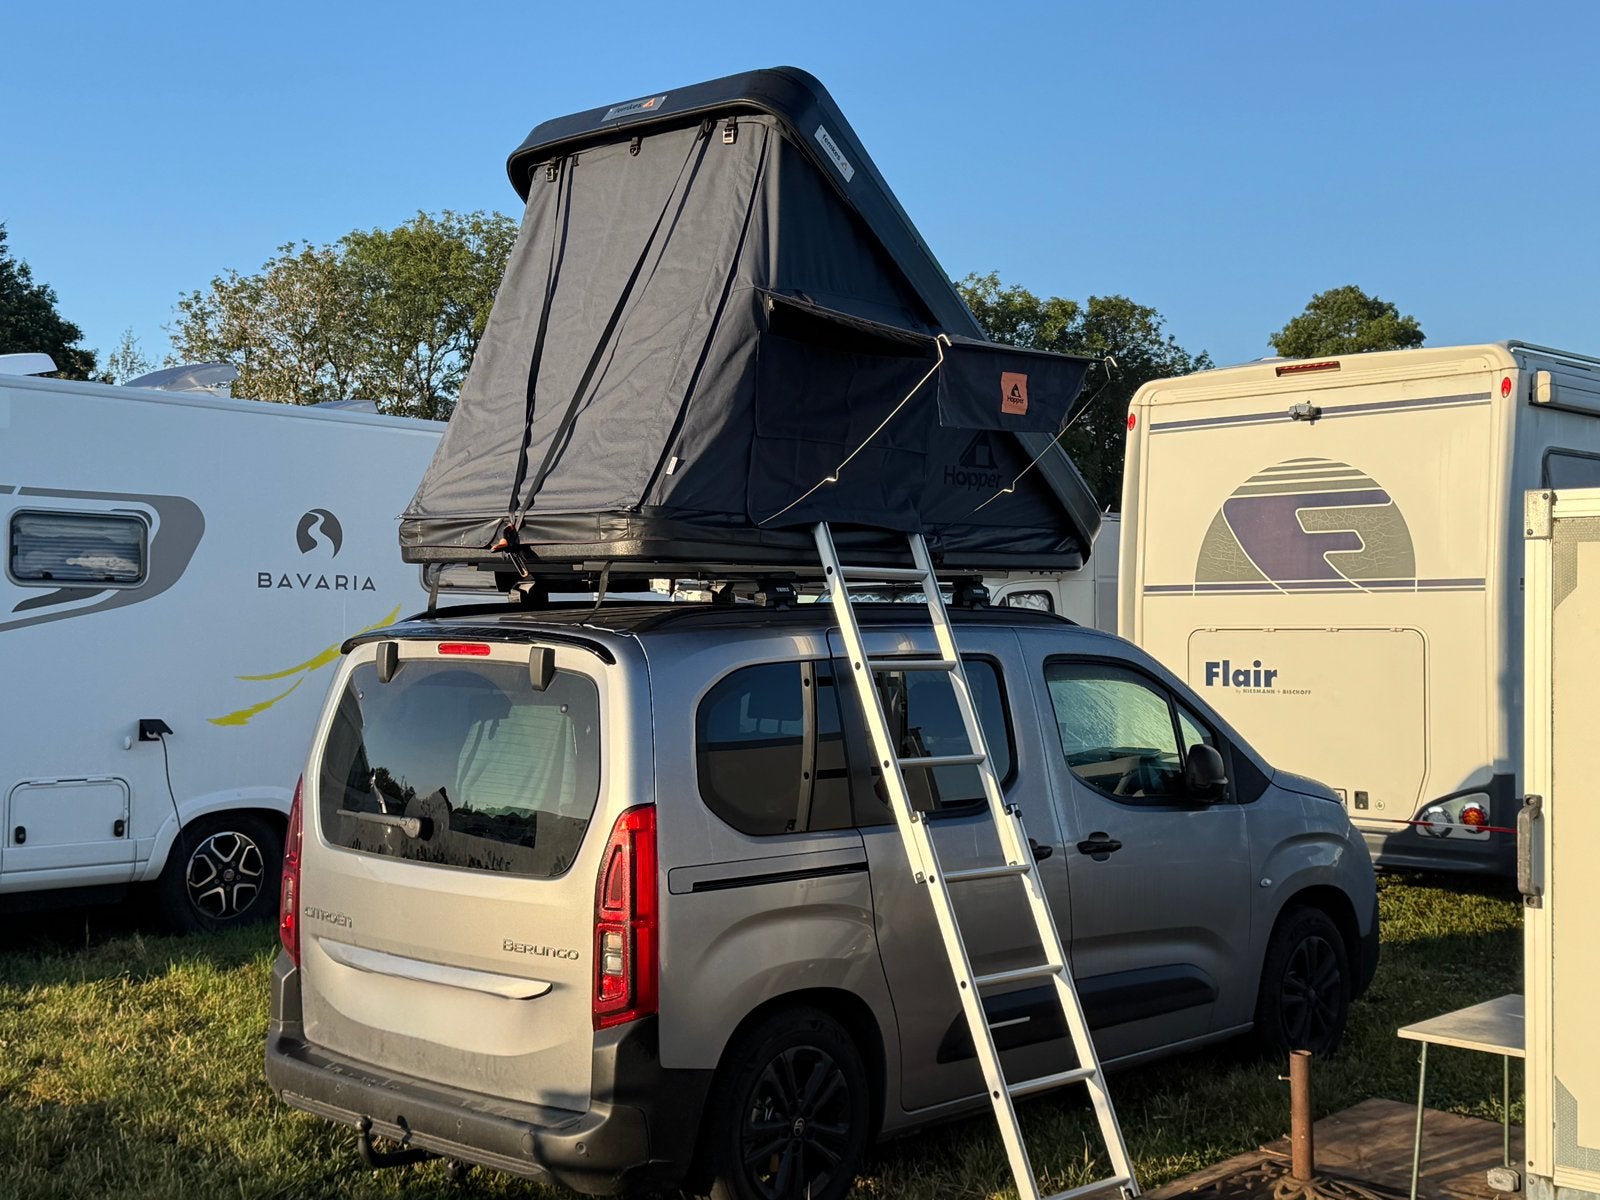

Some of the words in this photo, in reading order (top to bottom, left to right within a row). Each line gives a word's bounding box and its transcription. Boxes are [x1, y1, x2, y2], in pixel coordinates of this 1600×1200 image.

[1006, 394, 1025, 405] Hopper
[944, 464, 1003, 492] Hopper
[257, 572, 377, 592] BAVARIA
[1205, 660, 1278, 688] Flair
